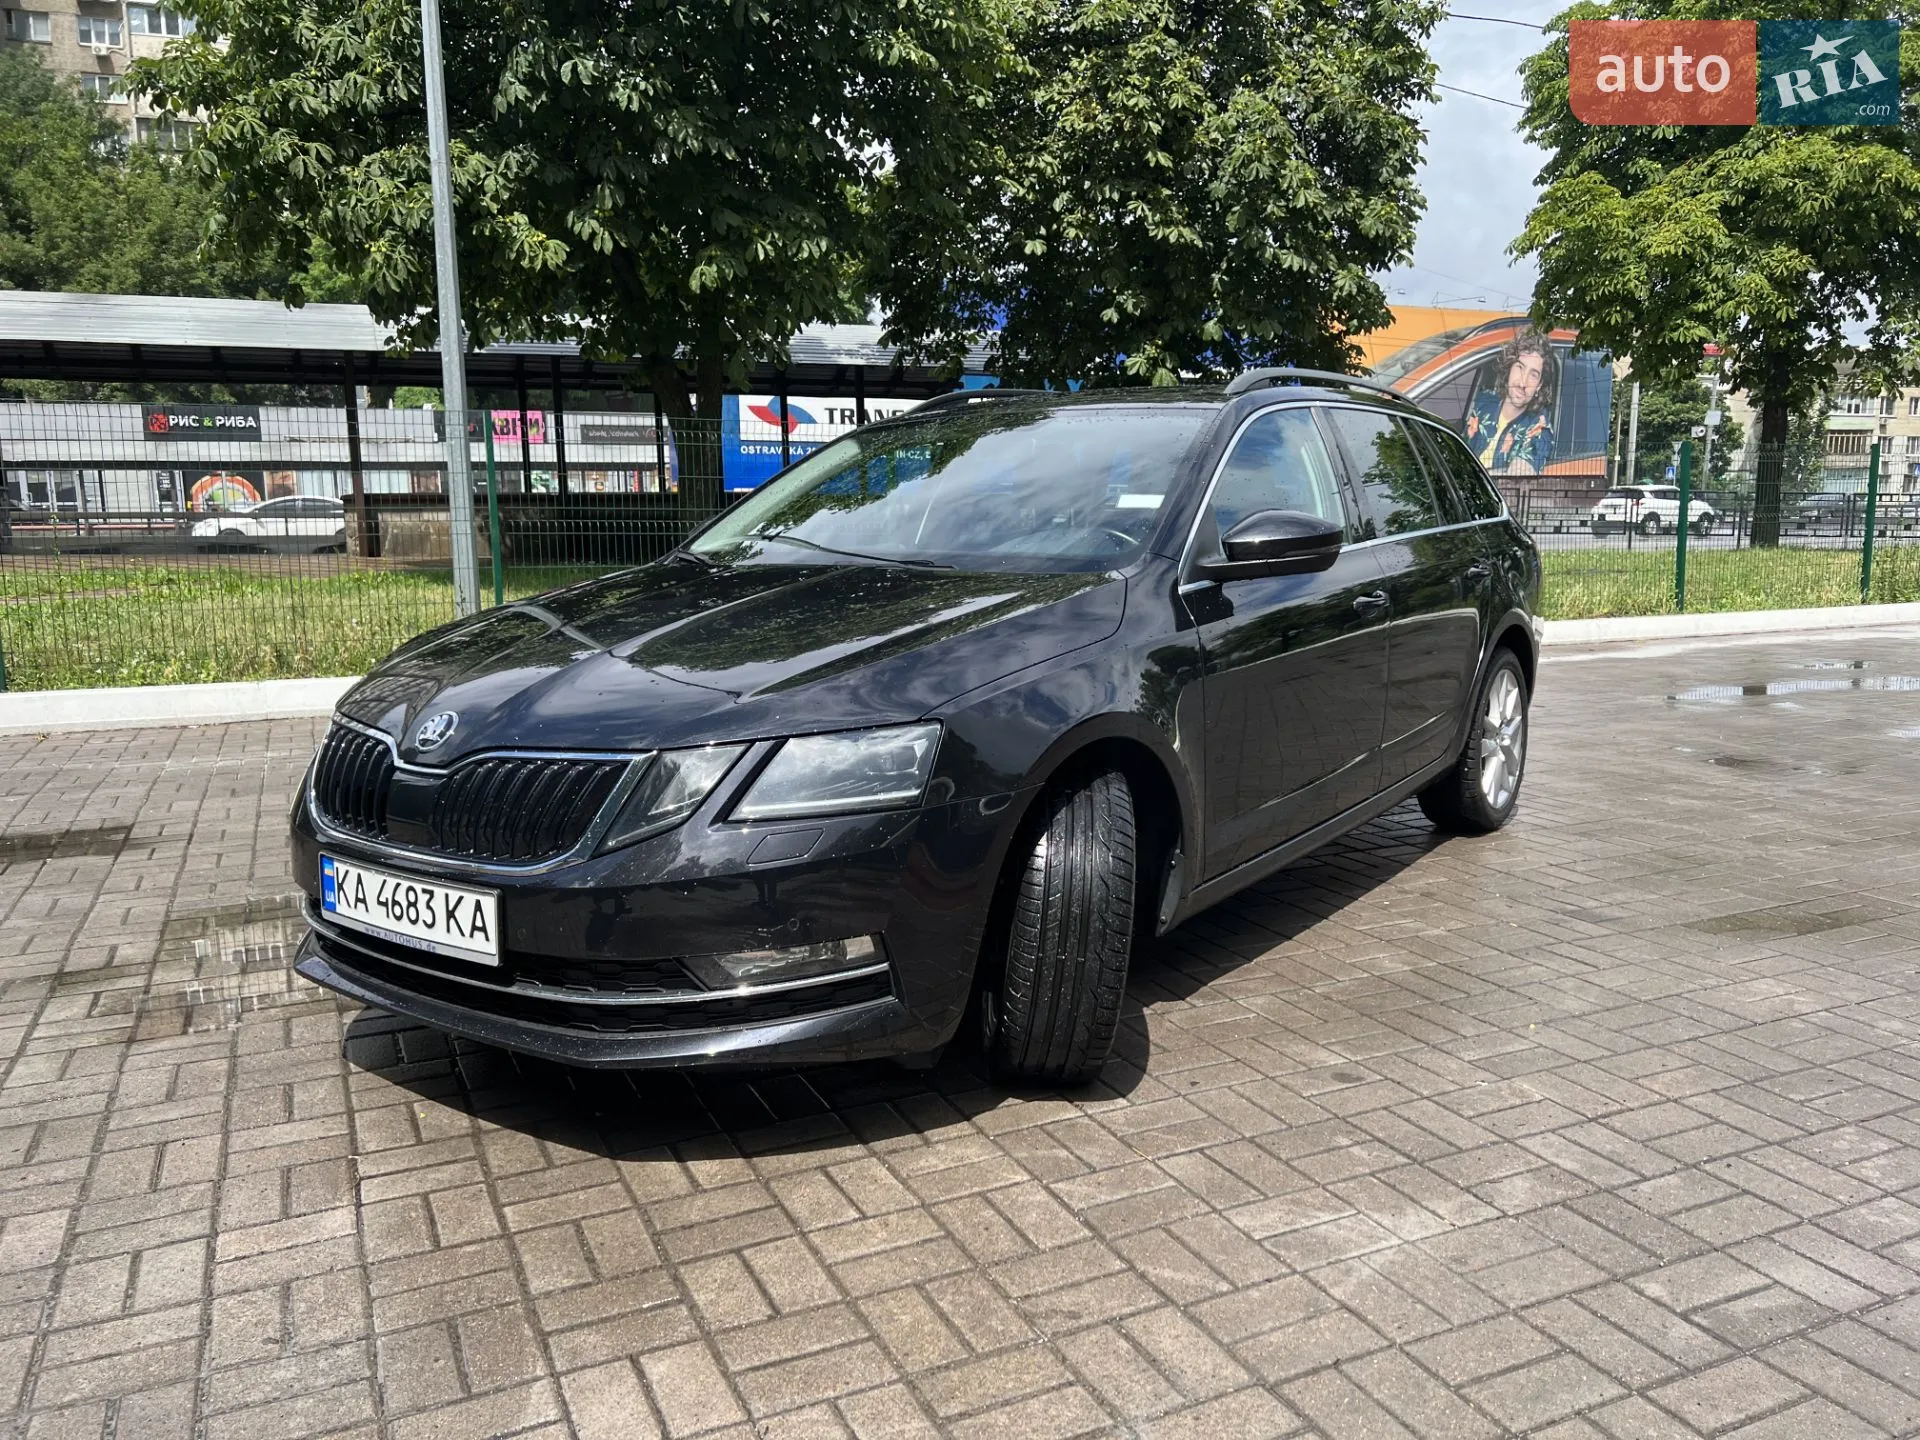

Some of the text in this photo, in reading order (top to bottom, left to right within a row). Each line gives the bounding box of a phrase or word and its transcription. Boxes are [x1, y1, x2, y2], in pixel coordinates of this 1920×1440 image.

[169, 415, 257, 428] РИС & РИБА
[740, 444, 804, 455] OSTRAVKÁ
[324, 889, 336, 903] UA
[335, 866, 491, 942] KA 4683 KA
[363, 926, 438, 953] www.AUTOHUS.de
